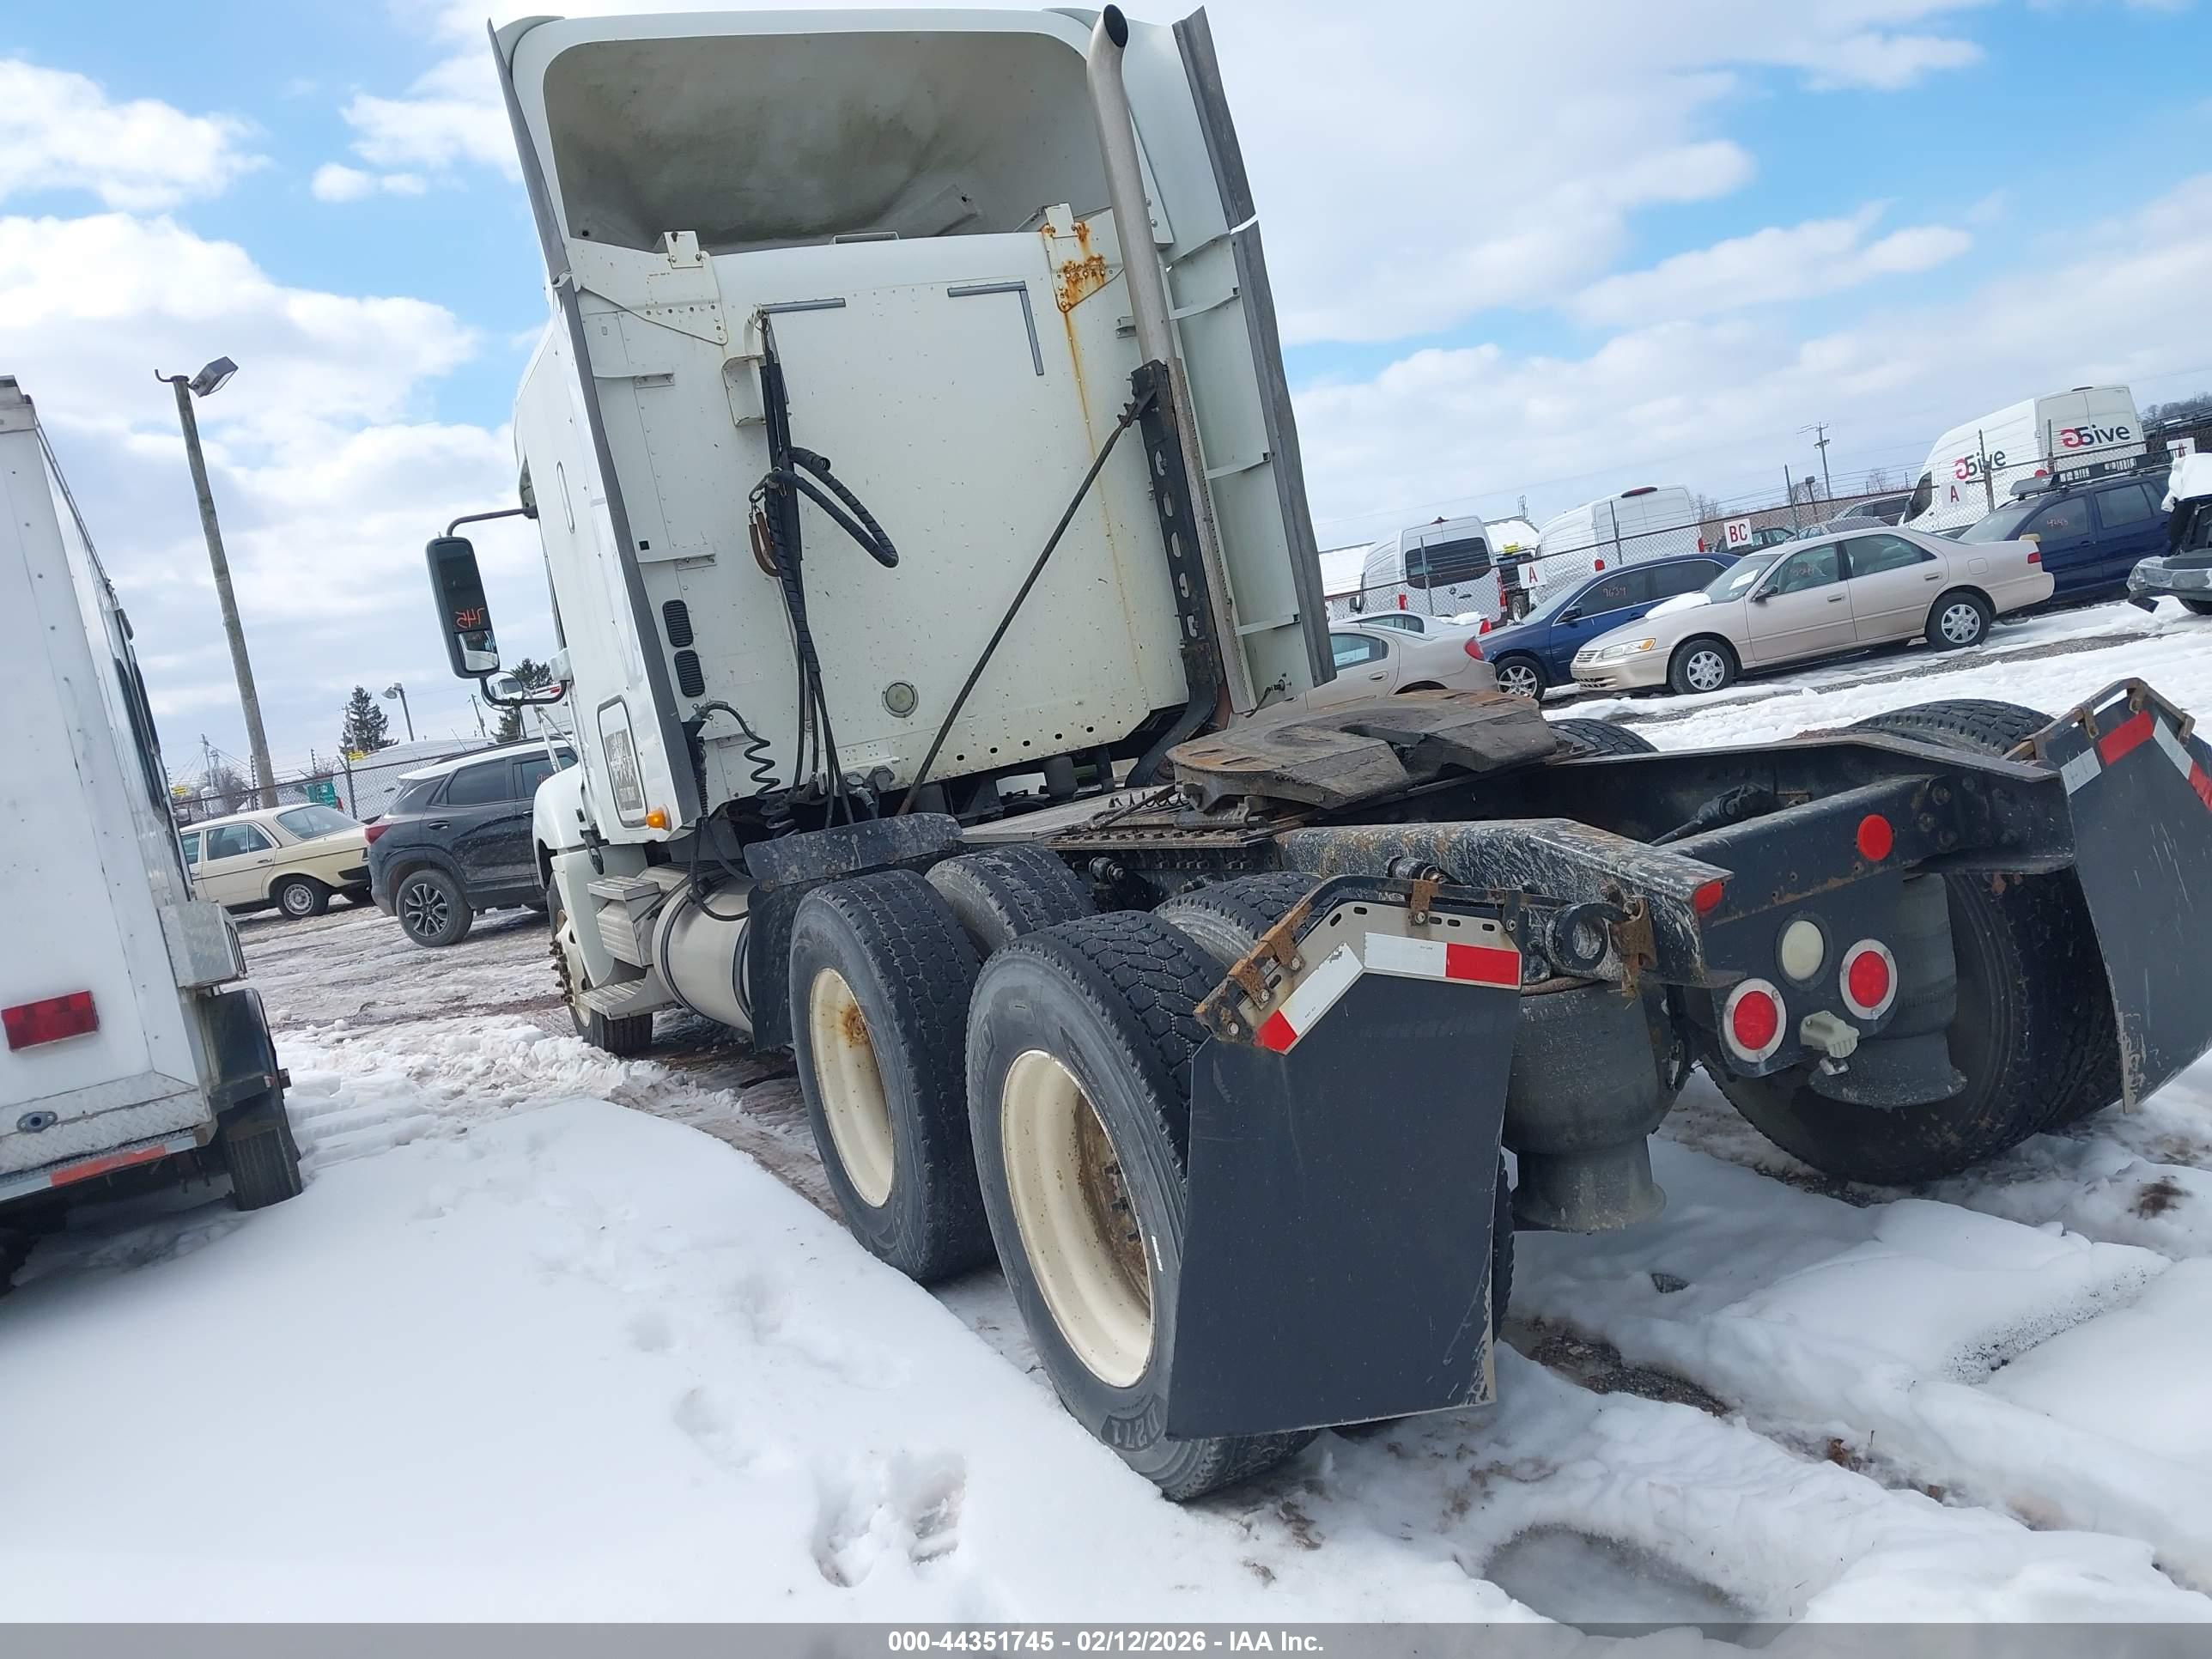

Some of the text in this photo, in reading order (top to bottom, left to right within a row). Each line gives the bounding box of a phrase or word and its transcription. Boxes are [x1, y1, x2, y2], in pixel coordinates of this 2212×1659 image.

[1950, 485, 1960, 503] A
[1729, 523, 1748, 543] BC
[1528, 566, 1539, 584] A
